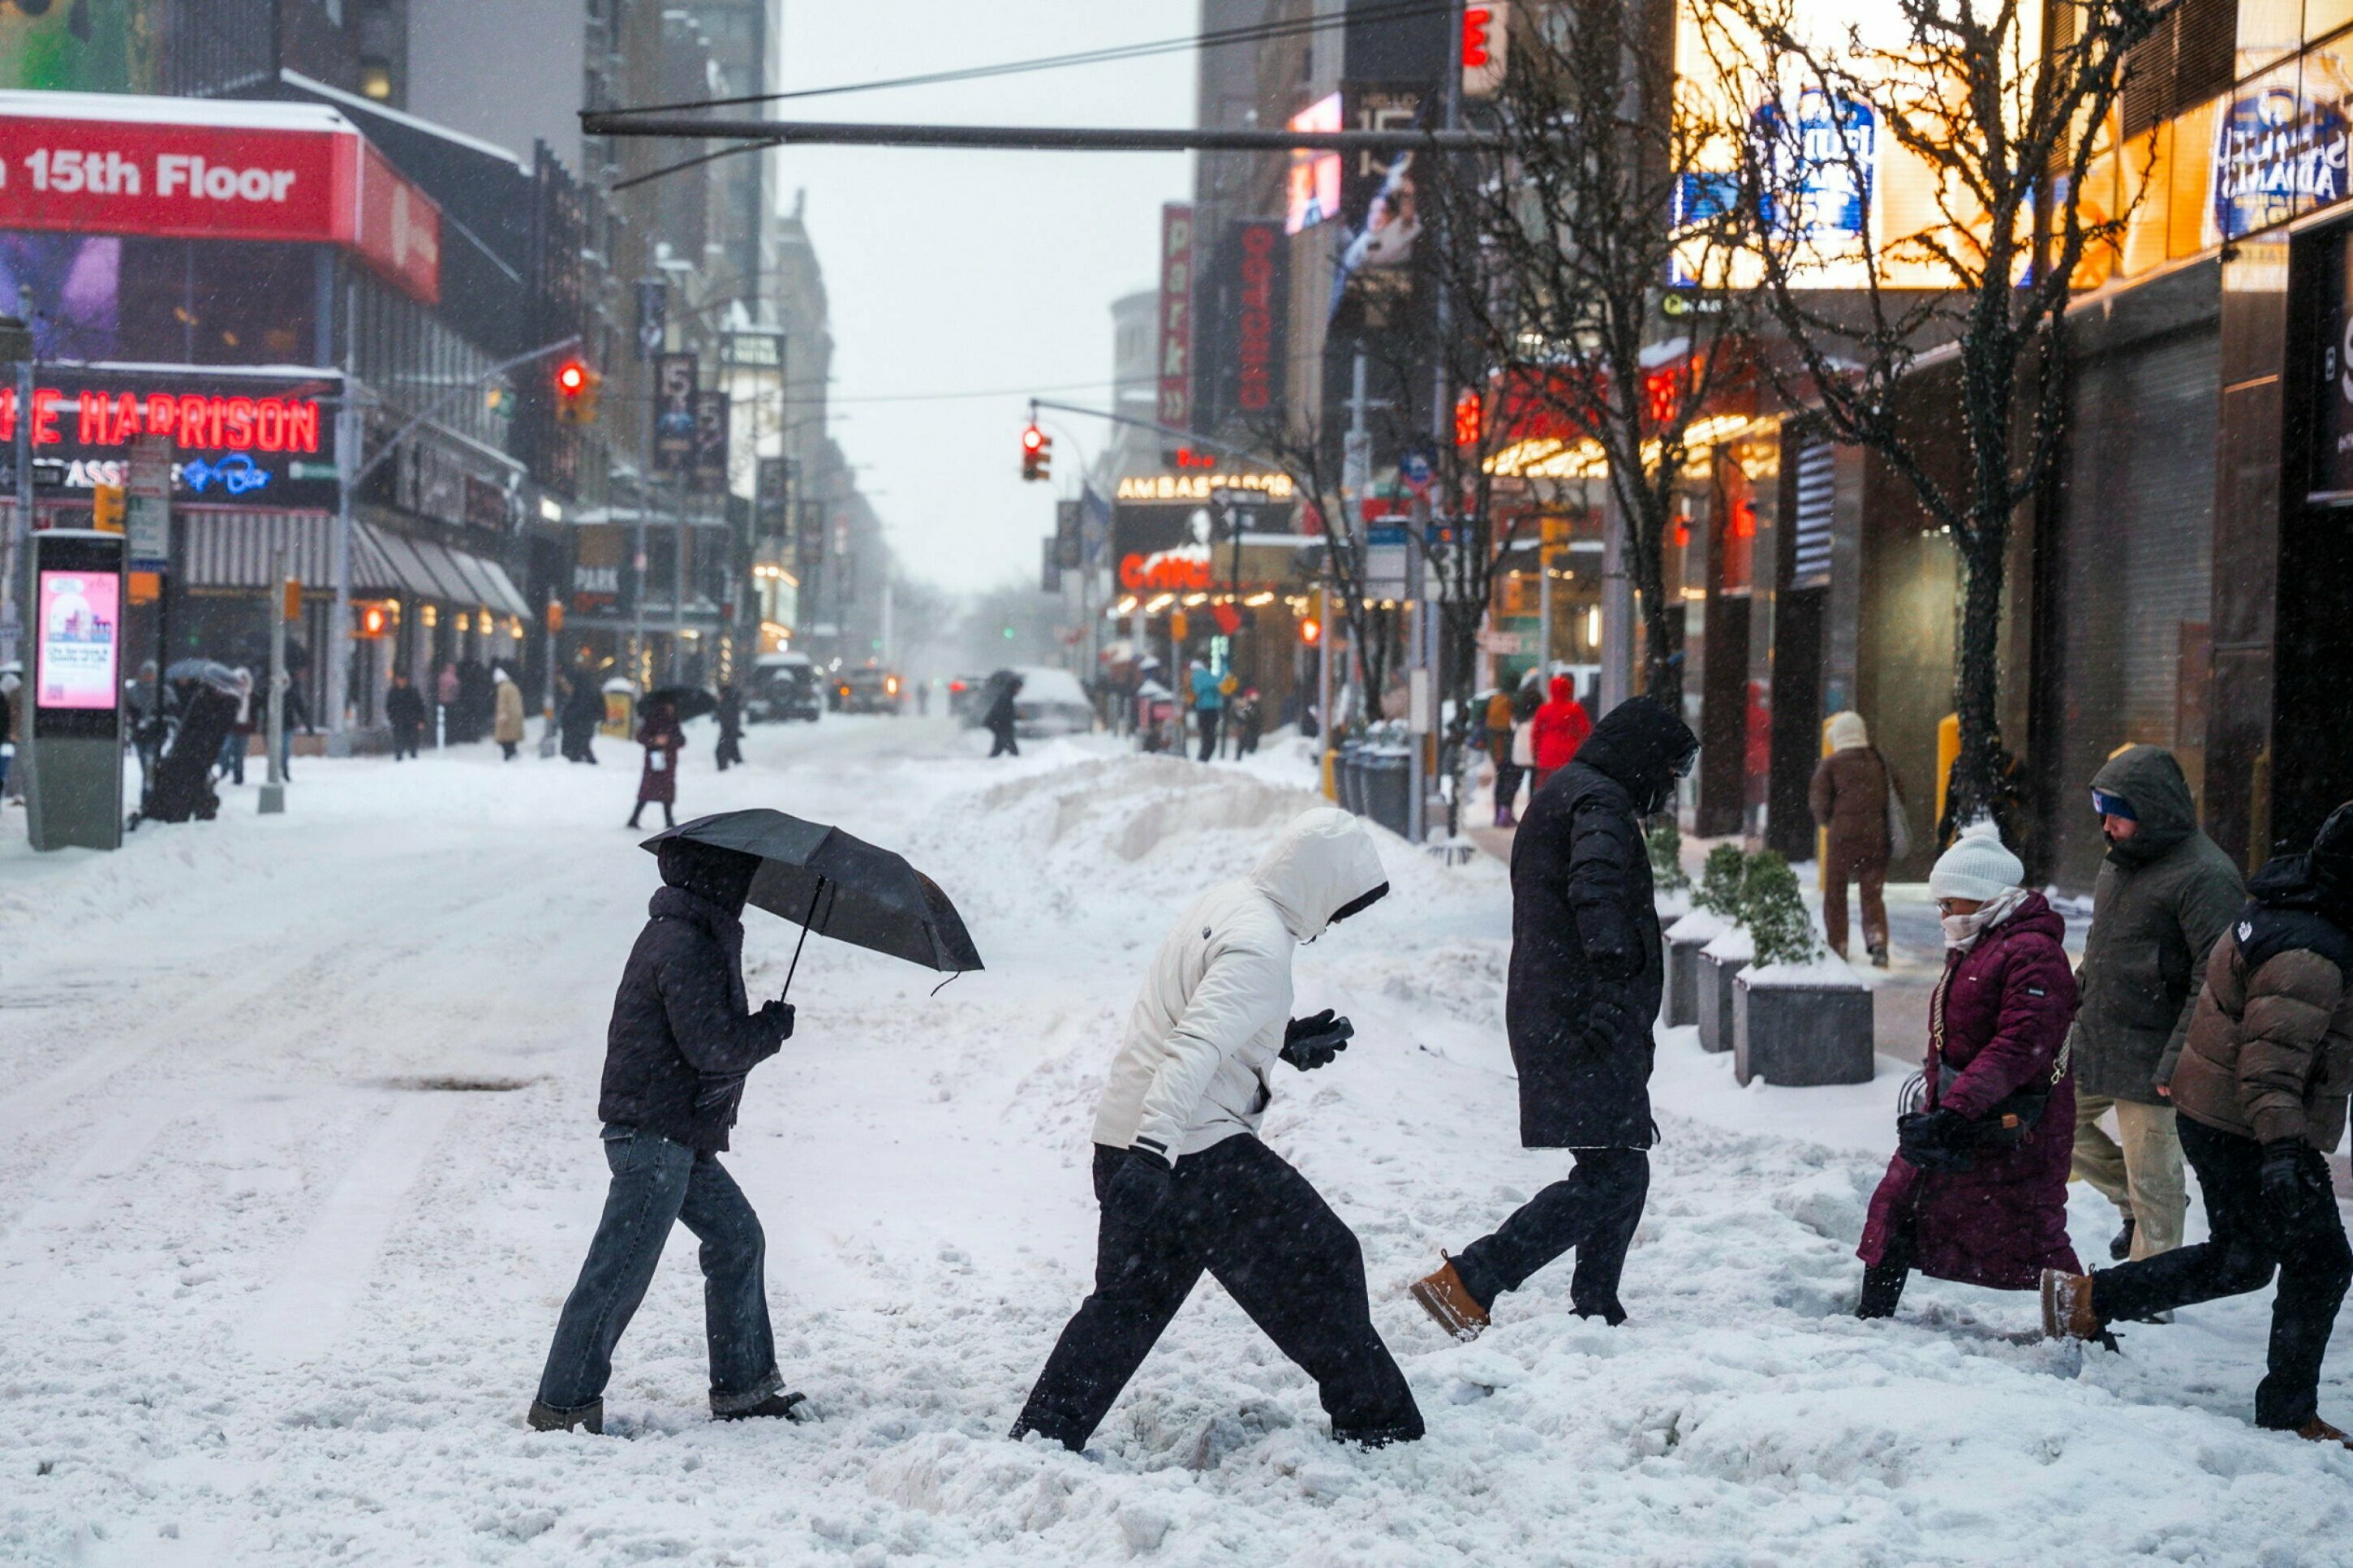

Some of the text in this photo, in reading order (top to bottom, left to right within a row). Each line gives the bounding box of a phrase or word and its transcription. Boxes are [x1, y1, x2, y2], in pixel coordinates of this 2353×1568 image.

[24, 148, 140, 195] 15th
[156, 153, 296, 202] Floor
[1238, 225, 1274, 411] CHICAGO
[78, 389, 319, 453] HARRISON
